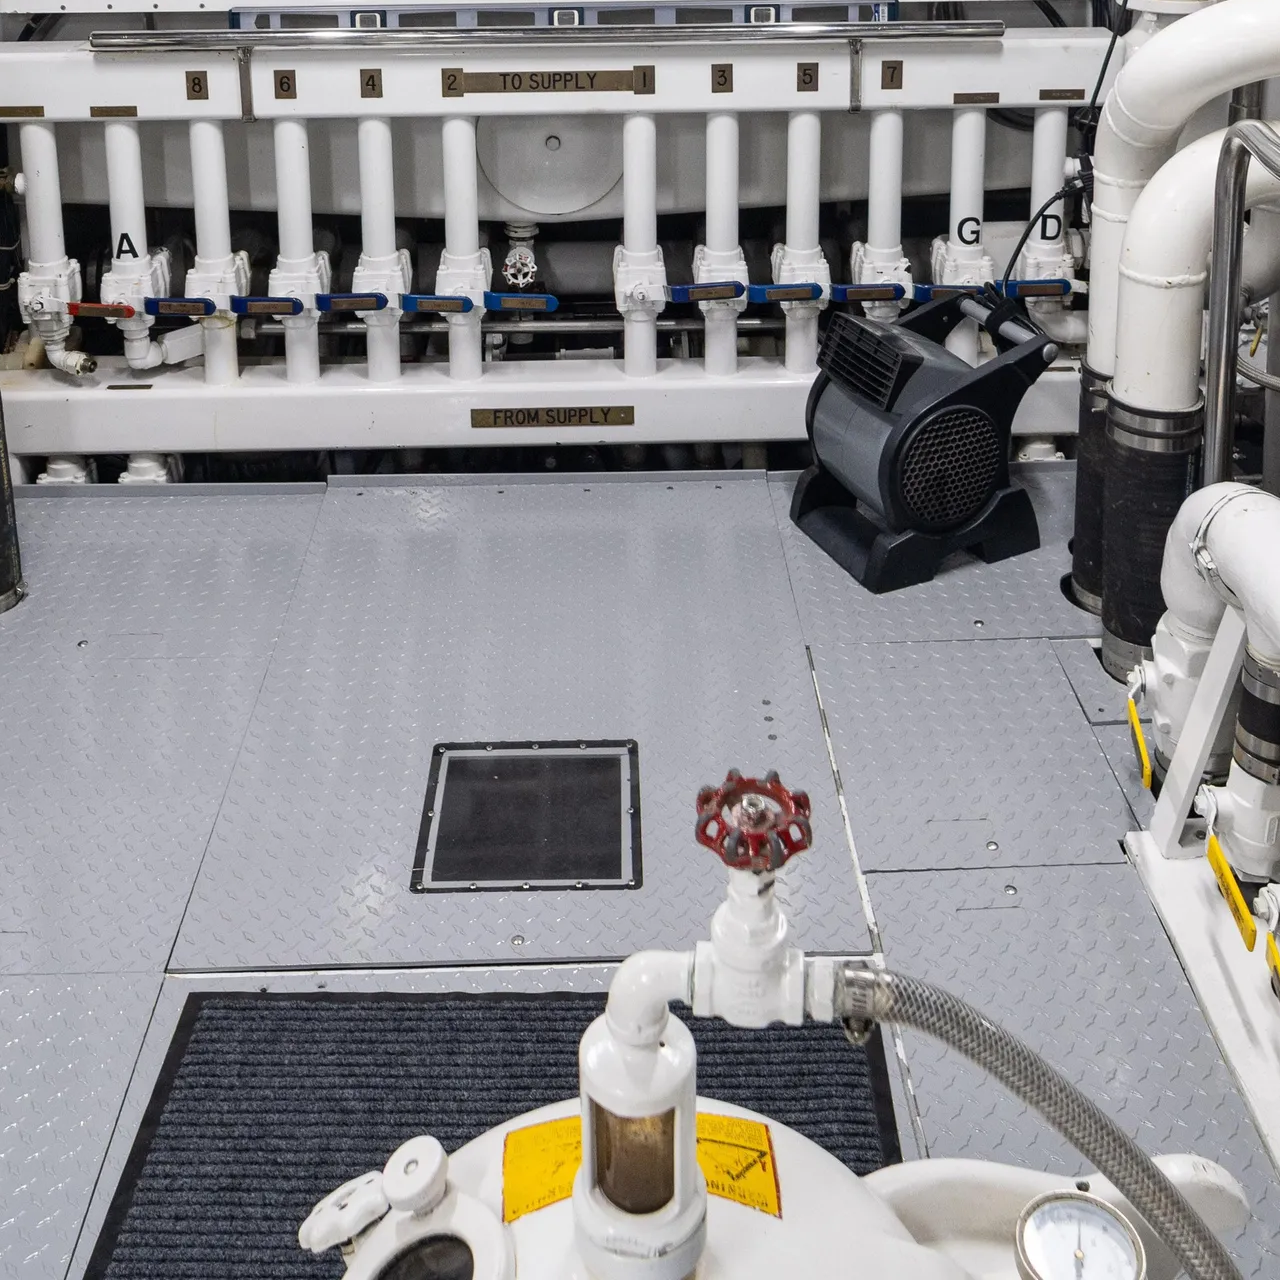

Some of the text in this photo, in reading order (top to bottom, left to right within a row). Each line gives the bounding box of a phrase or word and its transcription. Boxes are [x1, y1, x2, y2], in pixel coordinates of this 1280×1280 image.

[365, 74, 376, 91] 4
[447, 74, 458, 91] 2
[499, 71, 597, 90] TO SUPPLY
[642, 72, 647, 88] 1
[716, 70, 727, 86] 3
[802, 68, 813, 84] 5
[887, 66, 897, 83] 7
[192, 76, 202, 94] 8
[279, 76, 291, 93] 6
[957, 216, 981, 246] G
[1040, 214, 1062, 241] D
[115, 232, 140, 260] A
[493, 407, 611, 426] FROM SUPPLY
